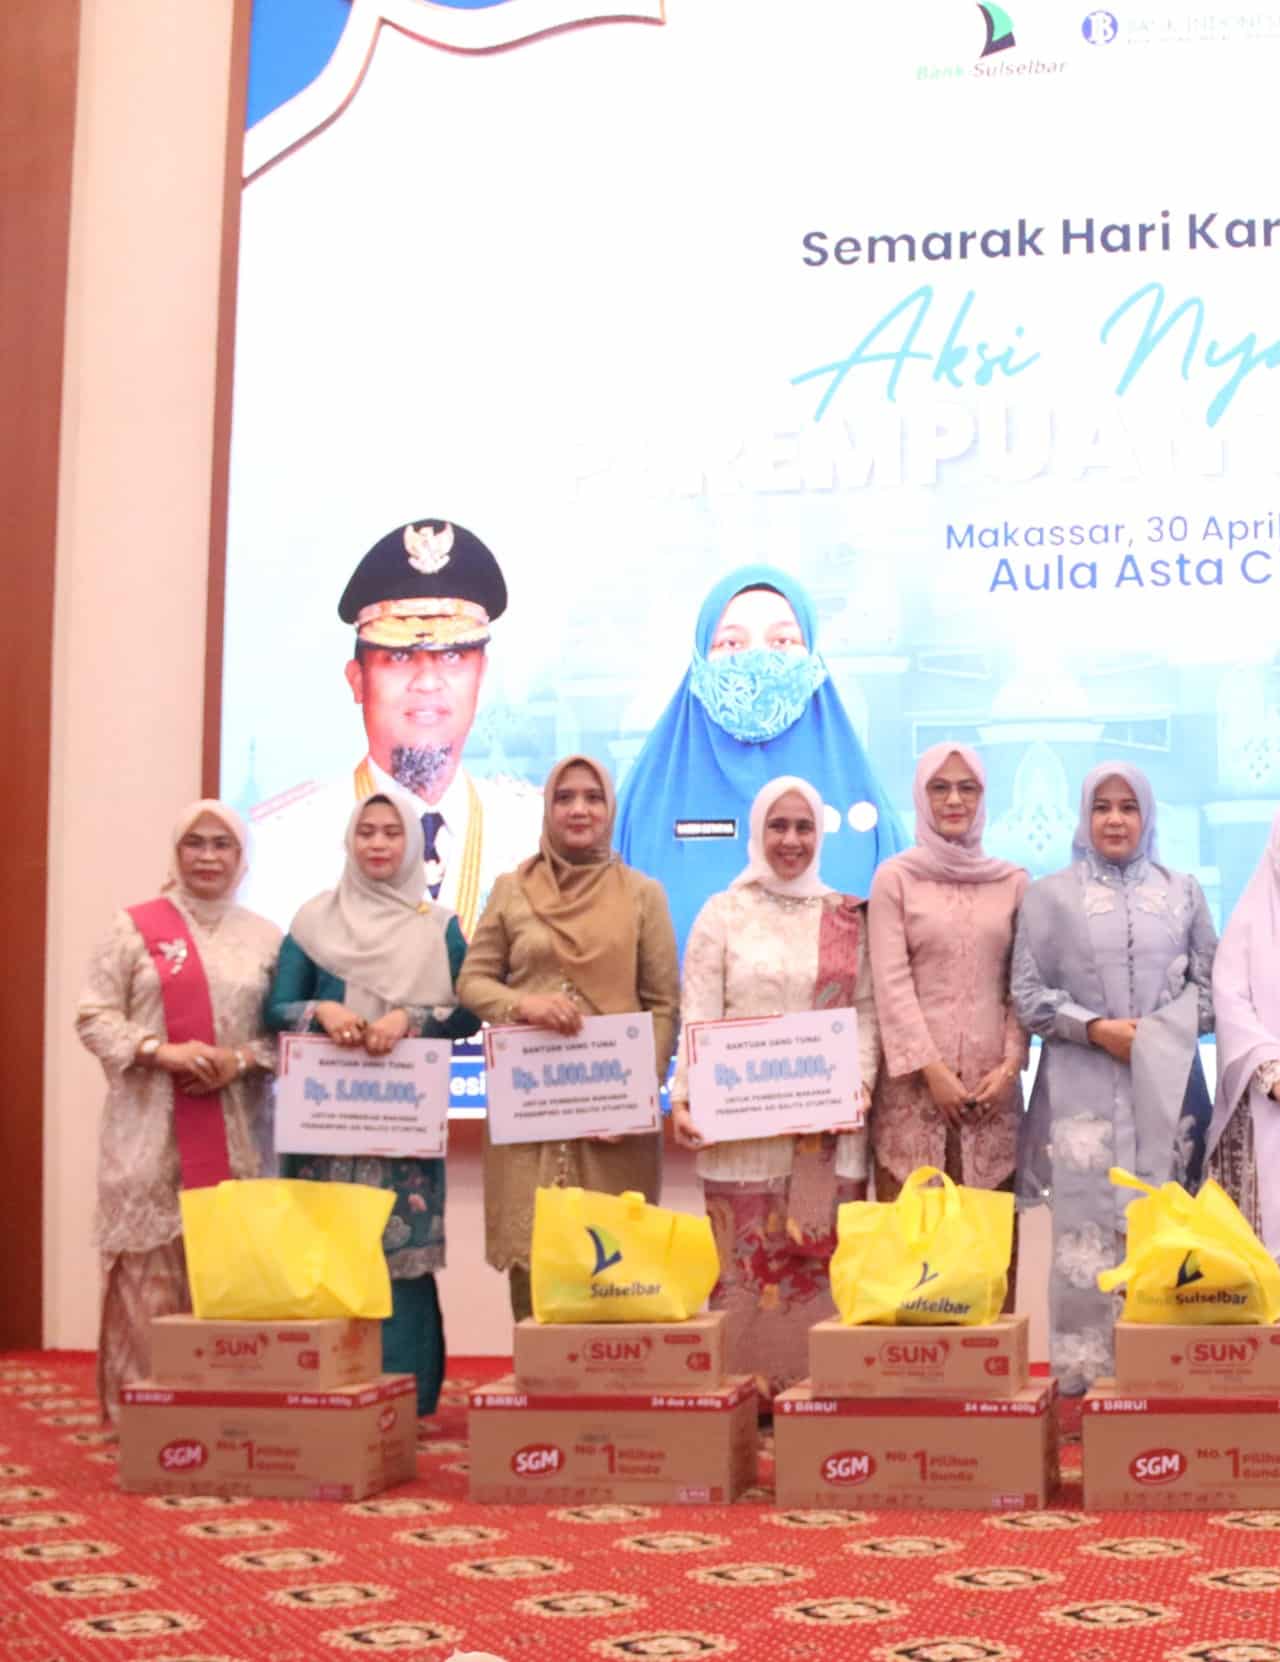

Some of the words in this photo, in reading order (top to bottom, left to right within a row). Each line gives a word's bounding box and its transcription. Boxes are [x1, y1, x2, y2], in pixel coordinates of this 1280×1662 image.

[972, 58, 1069, 78] Sulselbar
[802, 220, 1045, 267] Semarak
[1061, 211, 1171, 254] Hari
[790, 284, 1041, 423] Aksi
[946, 522, 1134, 549] Makassar,
[1146, 515, 1188, 542] 30
[990, 554, 1098, 592] Aula
[1114, 551, 1224, 588] Asta
[523, 1045, 562, 1054] BANTUAN
[591, 1040, 616, 1048] TUNAI
[726, 1042, 766, 1050] BANTUAN
[795, 1036, 821, 1044] TUNAI
[591, 1282, 662, 1299] Sulselbar
[1176, 1289, 1248, 1305] Sulselbar
[216, 1339, 257, 1356] SUN
[591, 1342, 642, 1360] SUN
[887, 1345, 938, 1364] SUN
[1194, 1343, 1246, 1361] SUN
[163, 1446, 202, 1467] SGM
[241, 1440, 255, 1471] 1
[515, 1450, 559, 1472] SGM
[601, 1443, 616, 1474] 1
[913, 1450, 928, 1481] 1
[1136, 1454, 1180, 1477] SGM
[1225, 1447, 1240, 1479] 1
[826, 1456, 869, 1479] SGM
